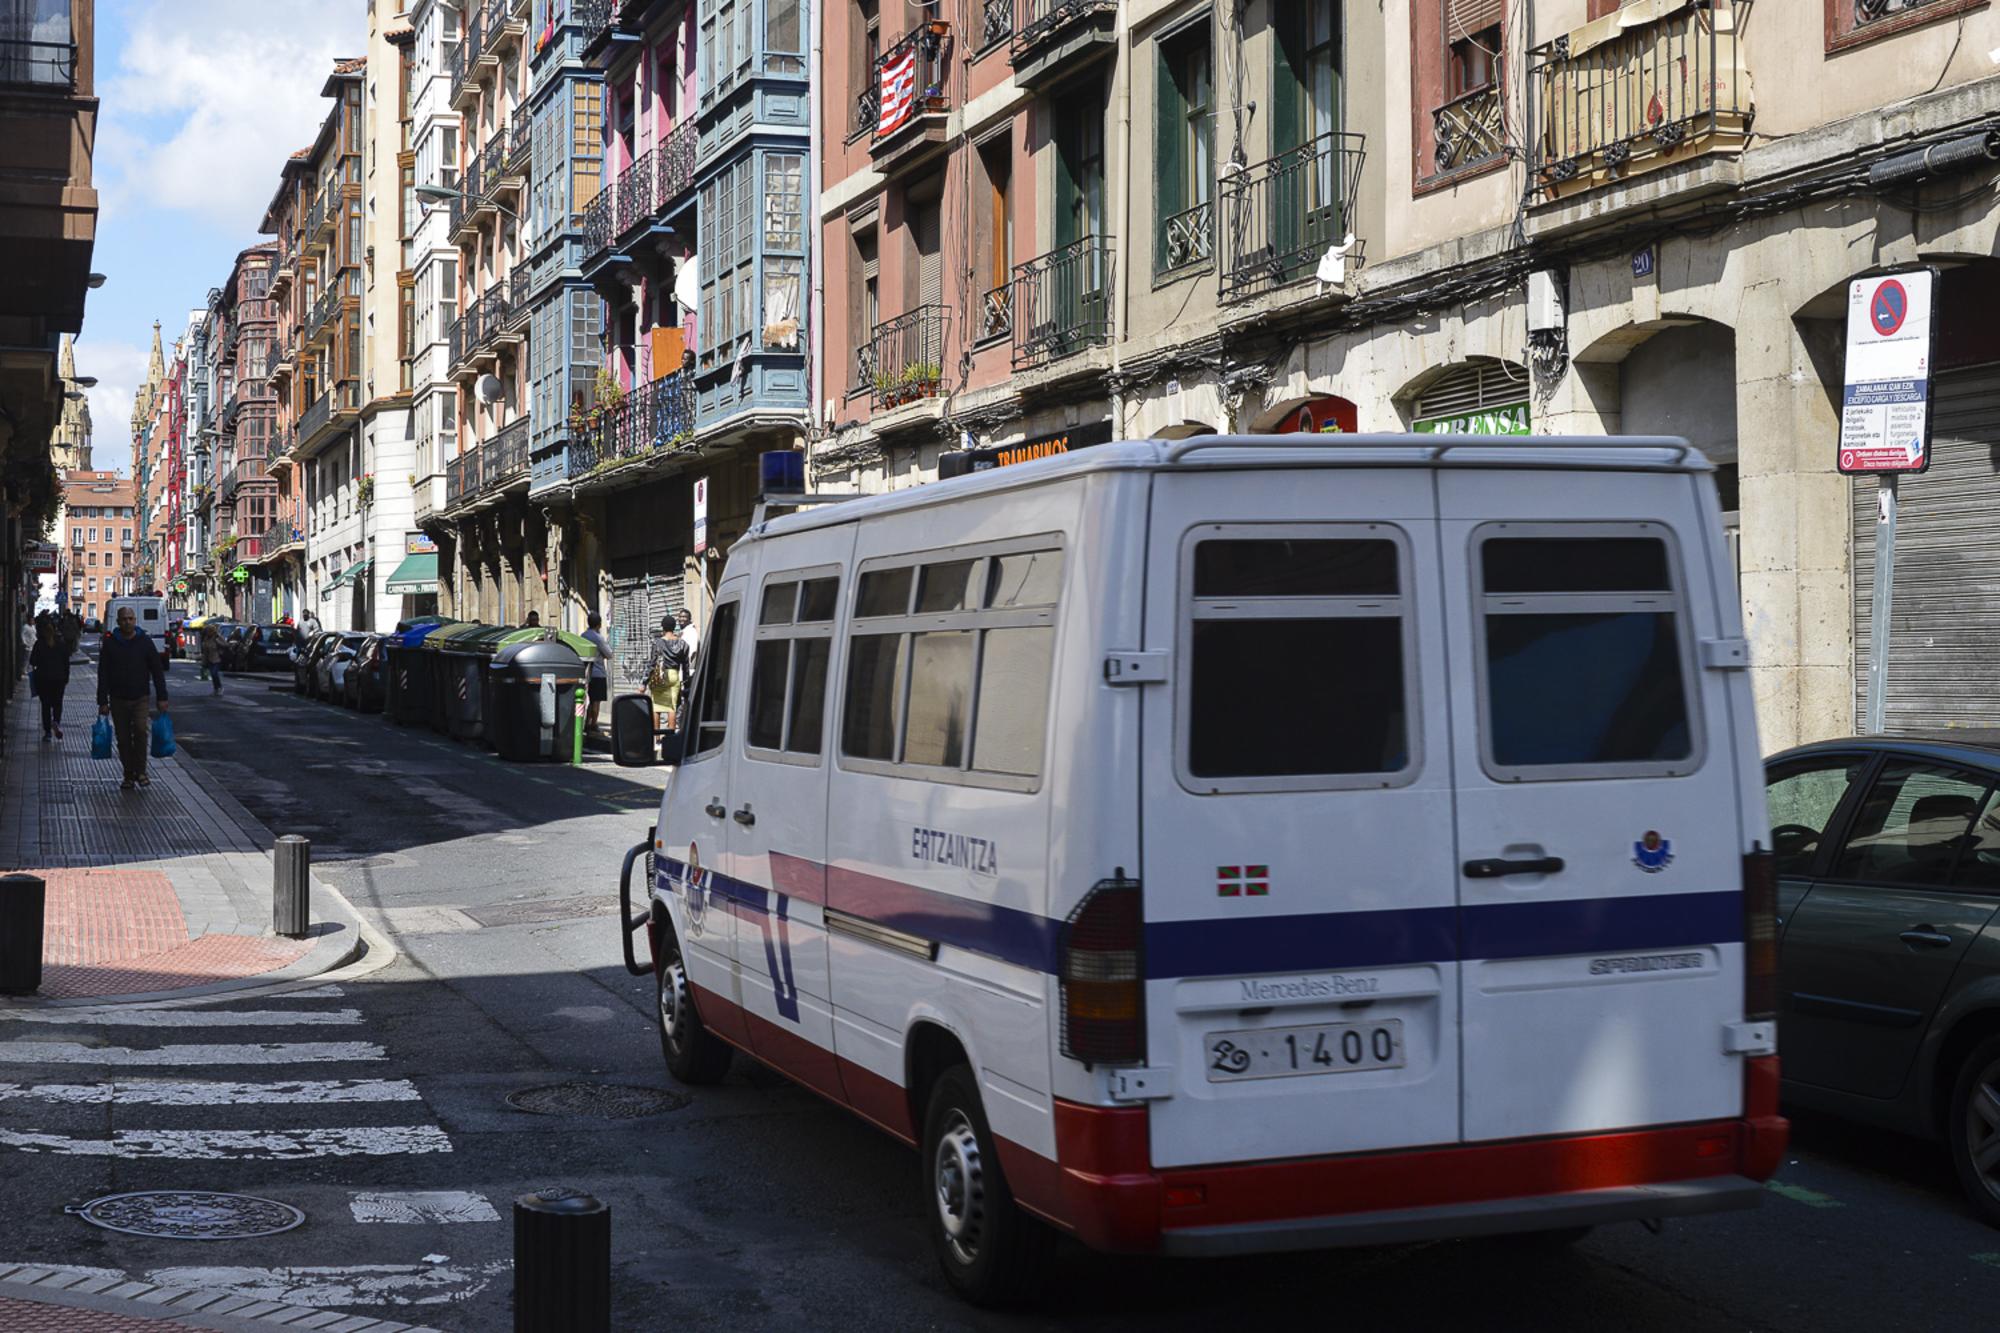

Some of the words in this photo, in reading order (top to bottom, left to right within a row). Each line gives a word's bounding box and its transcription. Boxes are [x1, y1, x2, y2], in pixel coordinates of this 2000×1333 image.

[1634, 252, 1649, 273] 20
[1434, 407, 1529, 434] PRENSA
[912, 827, 998, 875] ERTZAINTZA
